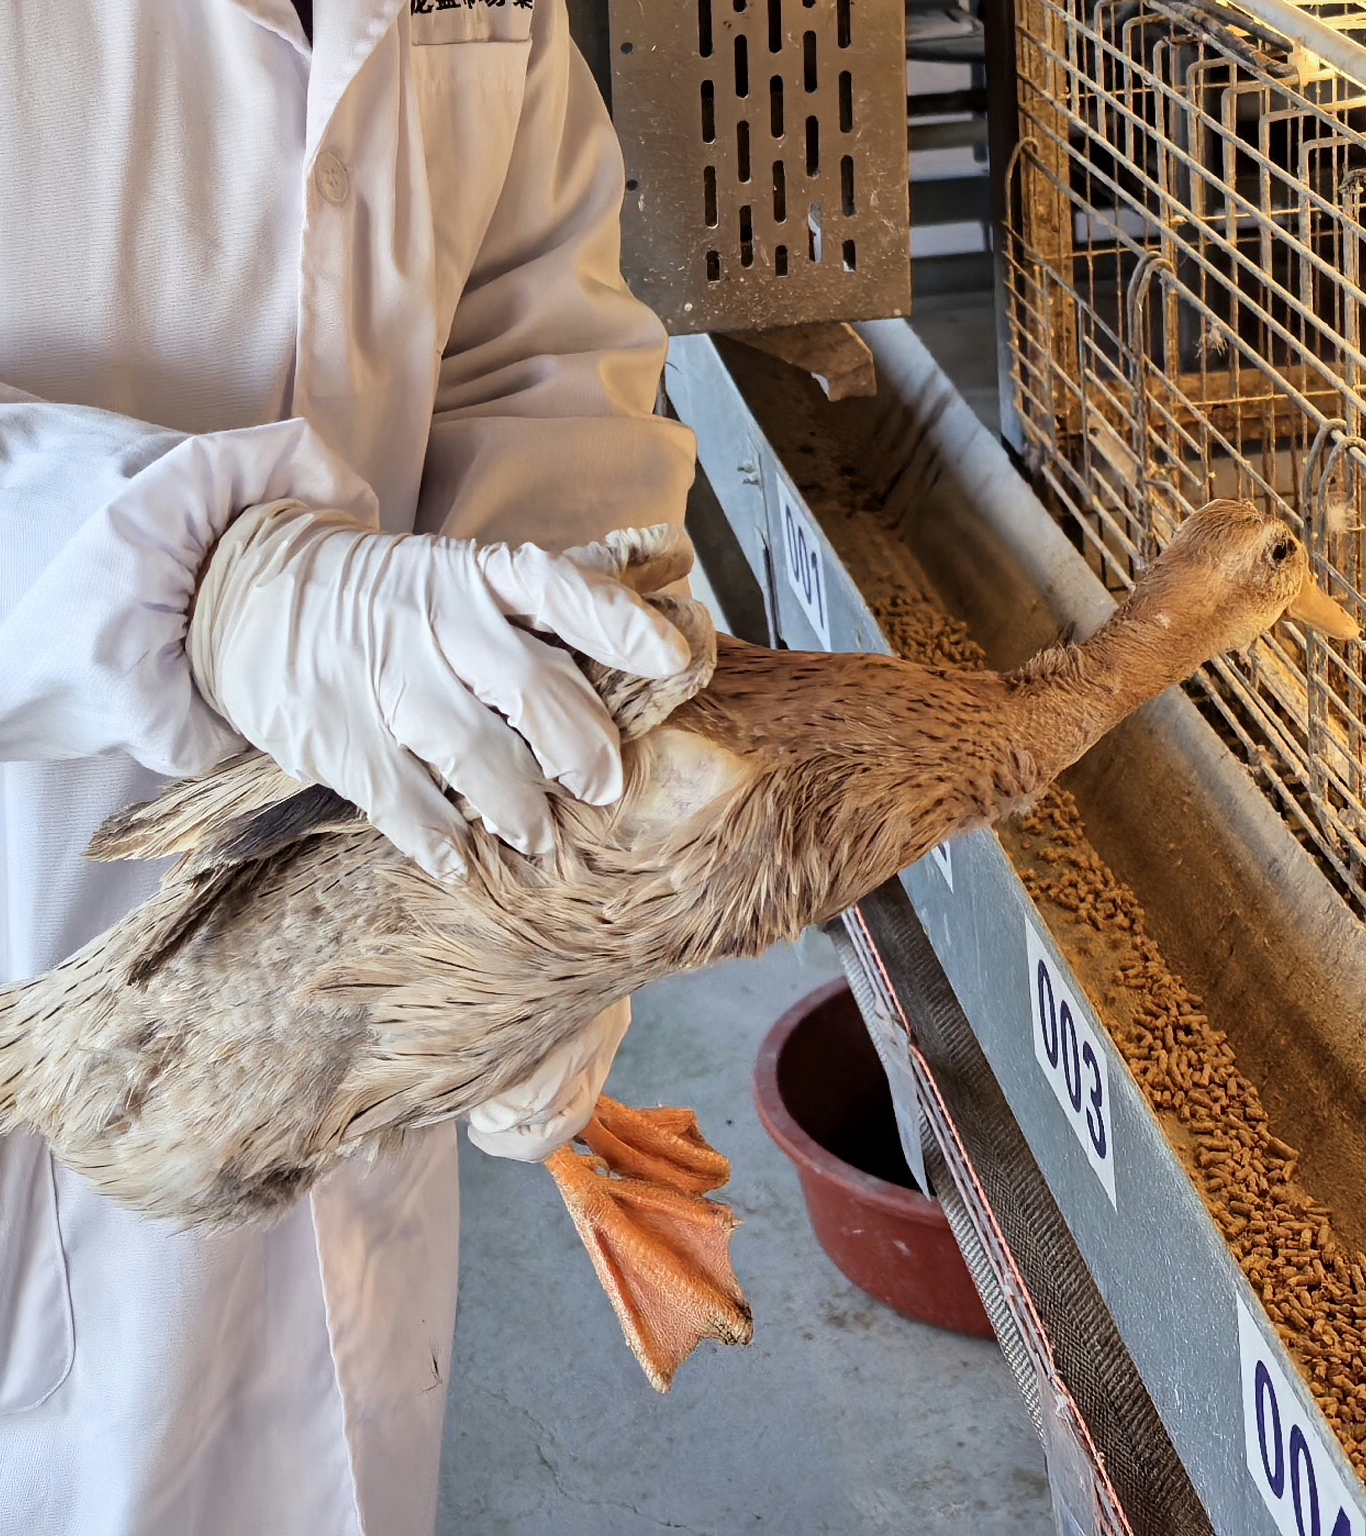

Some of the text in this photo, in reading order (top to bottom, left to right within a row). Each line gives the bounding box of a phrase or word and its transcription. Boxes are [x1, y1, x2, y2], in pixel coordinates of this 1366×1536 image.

[786, 504, 825, 630] 001
[1037, 959, 1107, 1160] 003
[1254, 1359, 1352, 1536] 00
